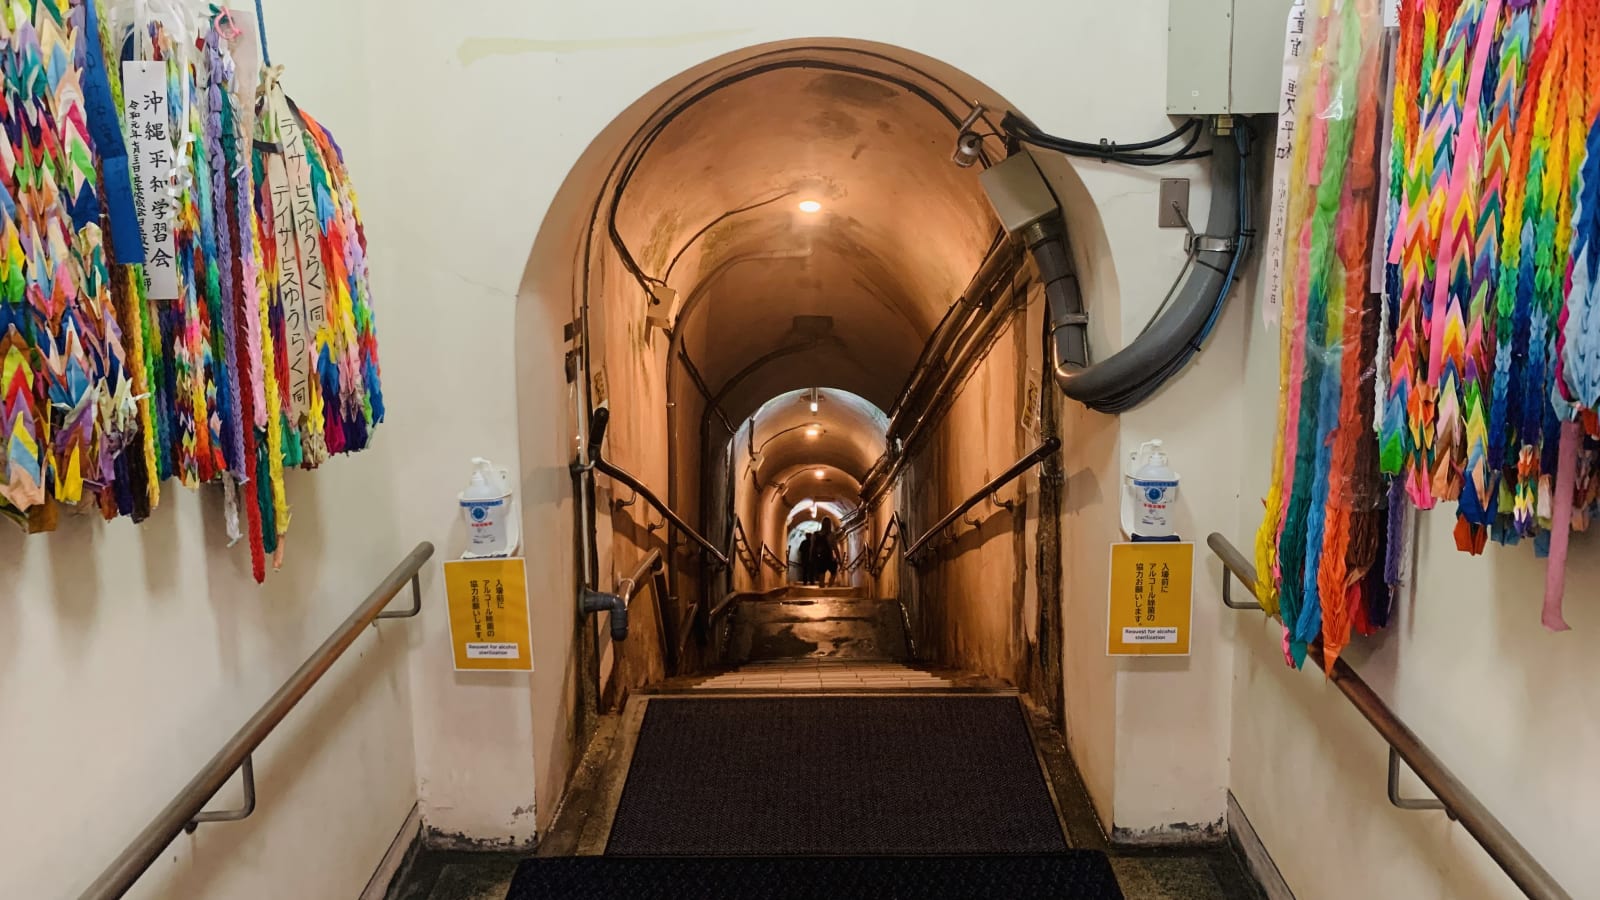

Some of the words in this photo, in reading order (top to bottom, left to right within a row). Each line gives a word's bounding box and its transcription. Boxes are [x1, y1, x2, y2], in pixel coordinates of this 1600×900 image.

[143, 90, 173, 269] 沖縄平和学習会
[495, 579, 505, 609] 入場前に
[1147, 562, 1157, 622] アルコール除菌の
[1161, 562, 1170, 593] 入場前に
[482, 579, 495, 637] アルコール除菌の
